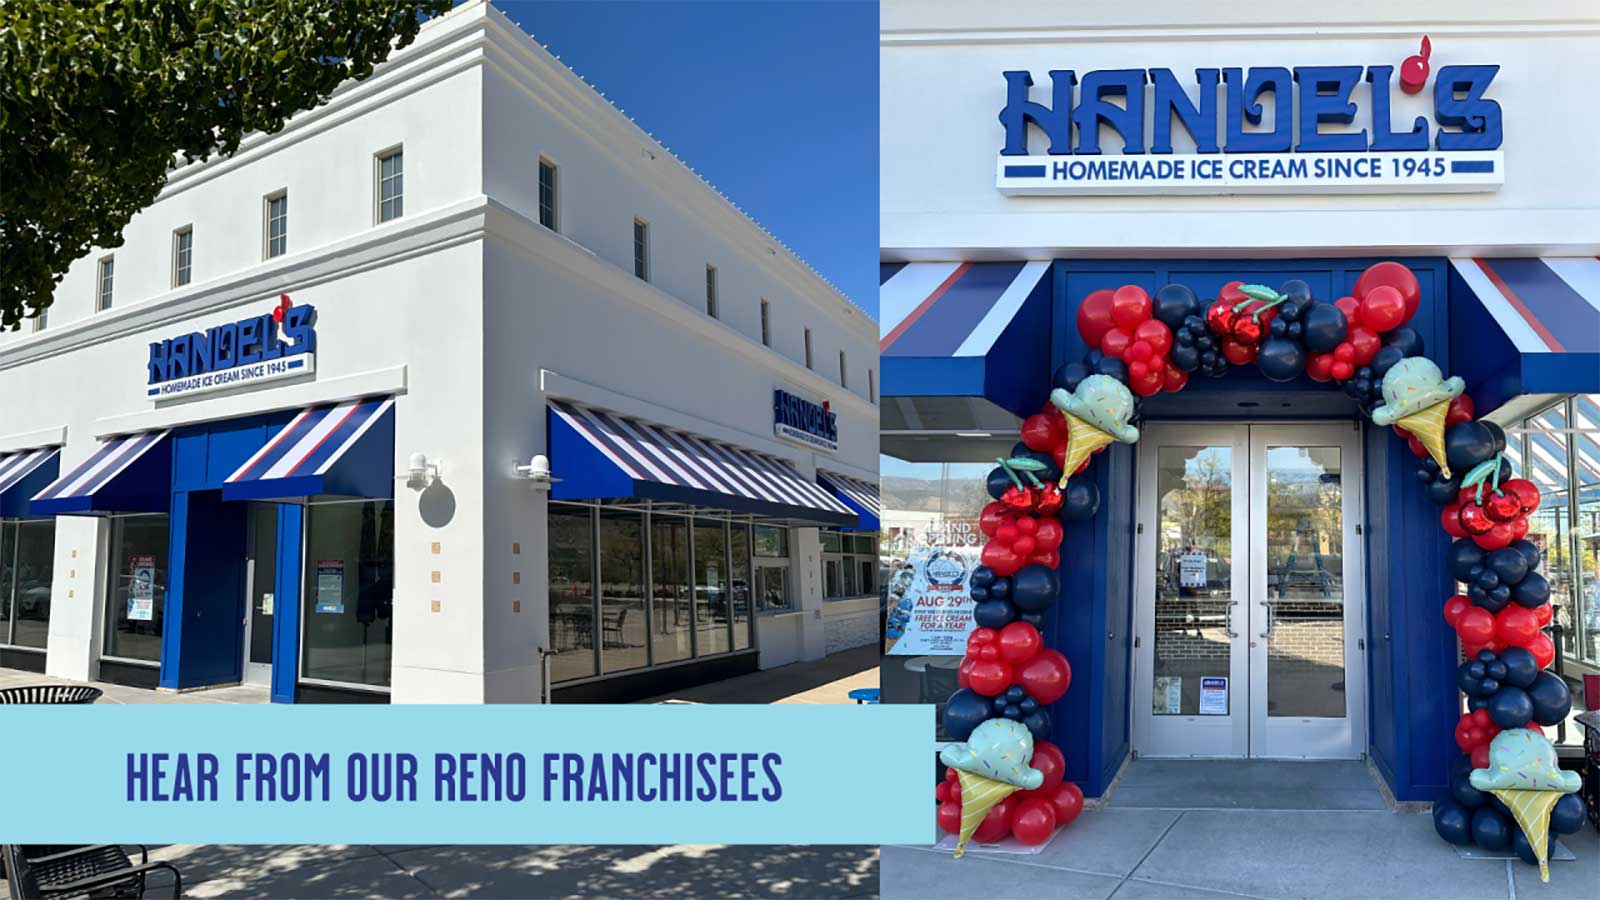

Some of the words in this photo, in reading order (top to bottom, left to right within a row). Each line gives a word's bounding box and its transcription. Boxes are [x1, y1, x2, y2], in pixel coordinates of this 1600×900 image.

[998, 37, 1503, 156] HANDEL'S
[1052, 159, 1185, 181] HOMEMADE
[1190, 159, 1223, 180] ICE
[1228, 158, 1309, 180] CREAM
[1313, 157, 1382, 179] SINCE
[1391, 157, 1446, 178] 1945
[148, 295, 317, 385] HANDEL'S
[160, 376, 202, 395] HOMEMADE
[202, 375, 213, 387] ICE
[213, 370, 240, 386] CREAM
[241, 365, 265, 381] SINCE
[266, 361, 287, 375] 1945
[916, 595, 945, 607] AUG
[945, 614, 972, 622] CREAM
